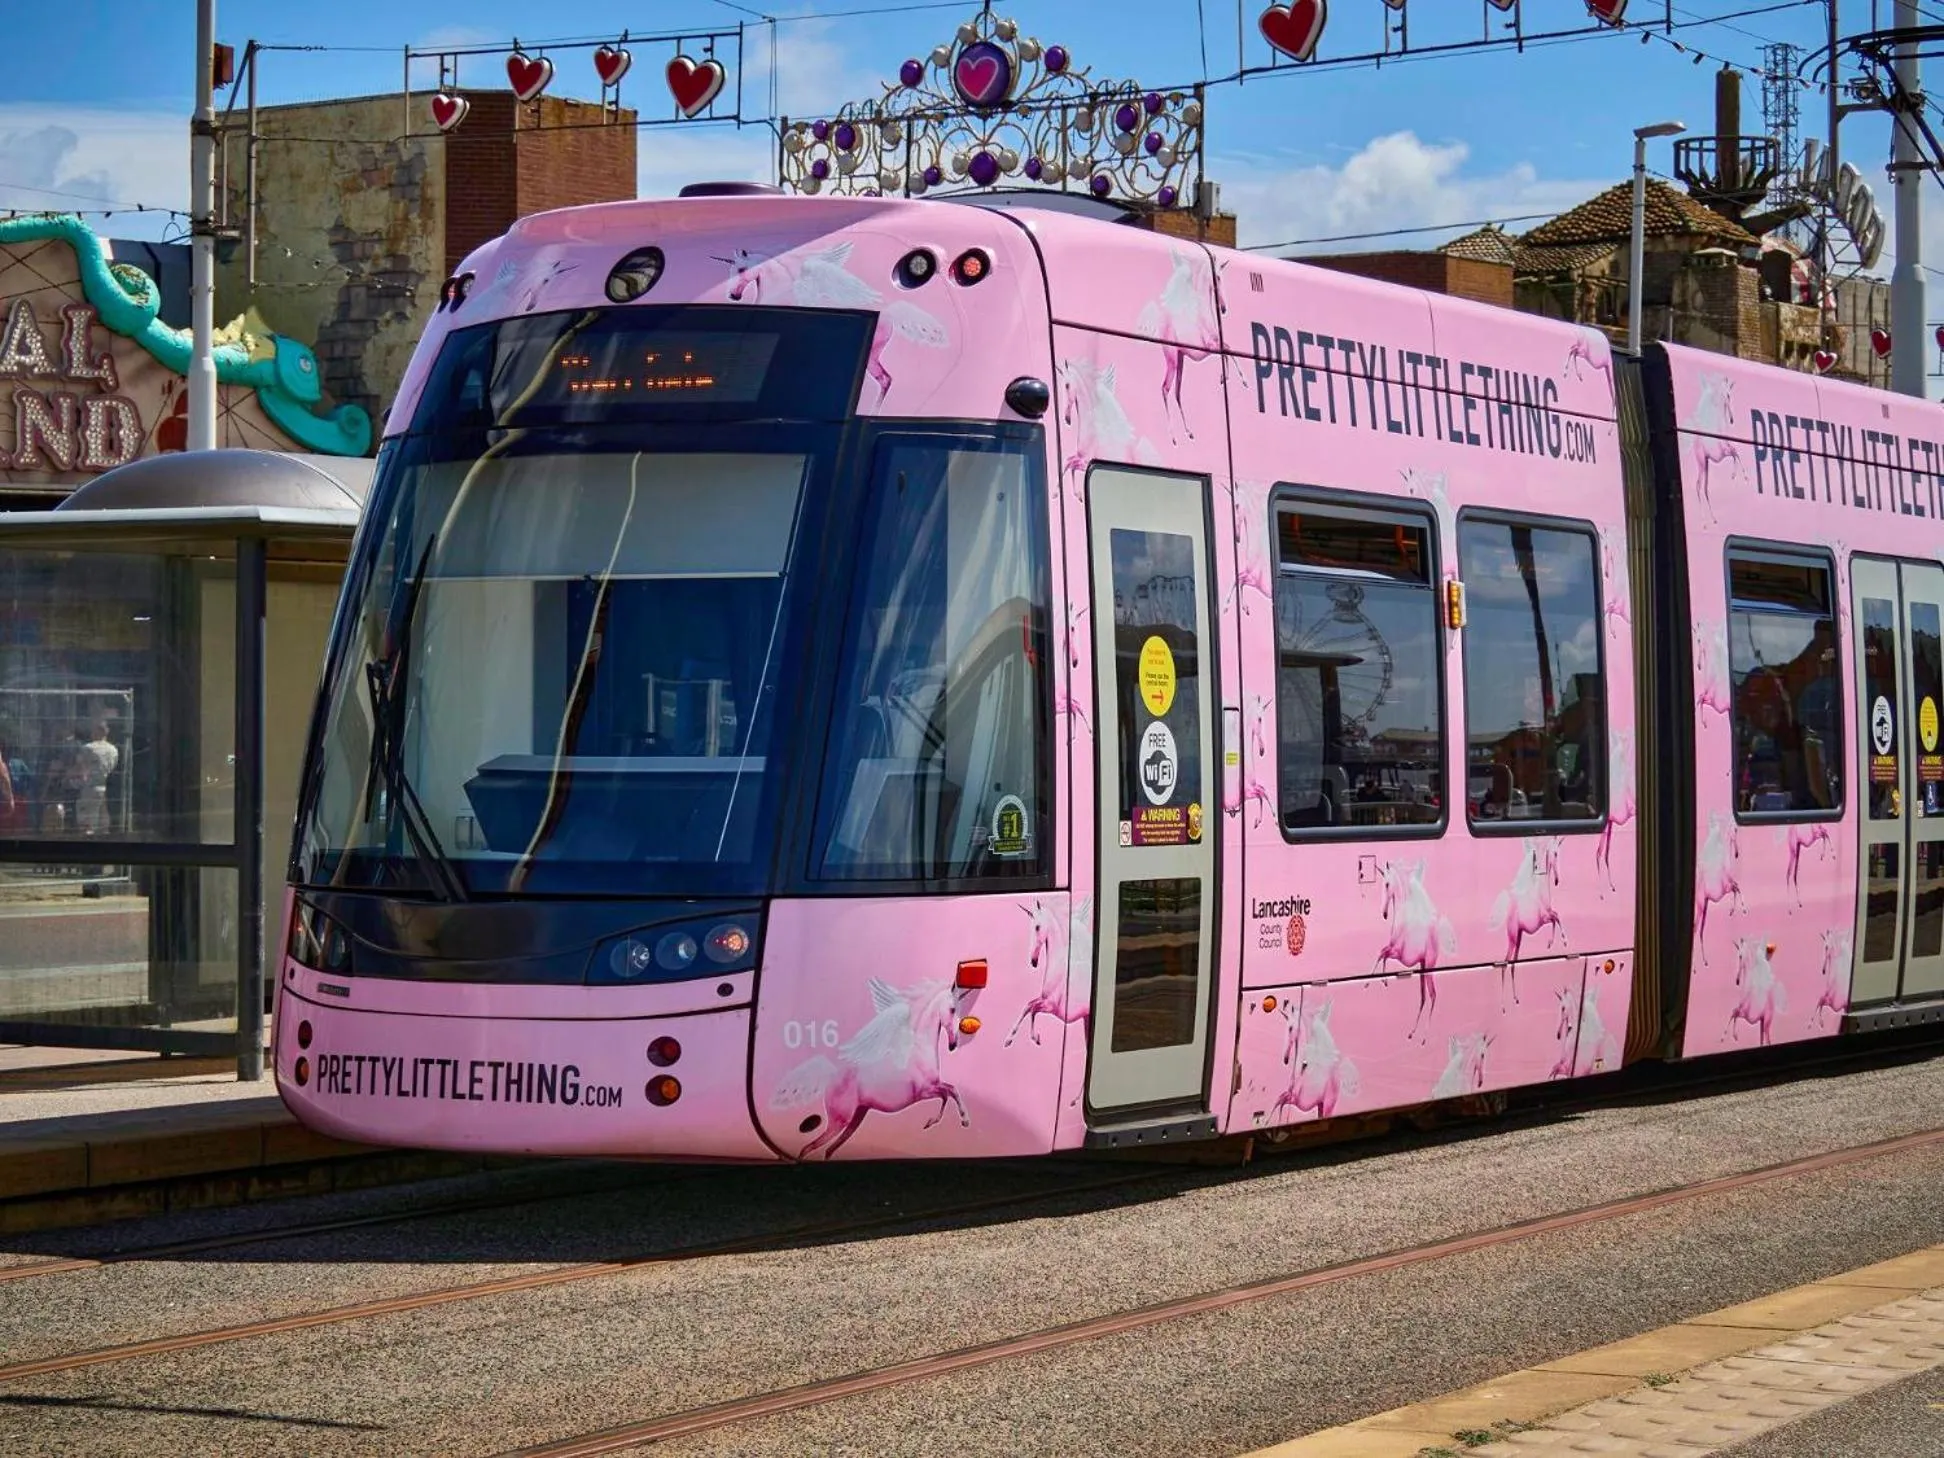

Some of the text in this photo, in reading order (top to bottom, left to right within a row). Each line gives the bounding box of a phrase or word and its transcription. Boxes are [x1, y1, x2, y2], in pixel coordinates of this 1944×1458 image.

[1251, 321, 1597, 464] PRETTYLITTLETHING.COM
[1148, 732, 1166, 748] FREE
[1252, 894, 1311, 919] Lancashire
[783, 1019, 839, 1049] 016
[317, 1053, 622, 1108] PRETTYLITTLETHING.COM
